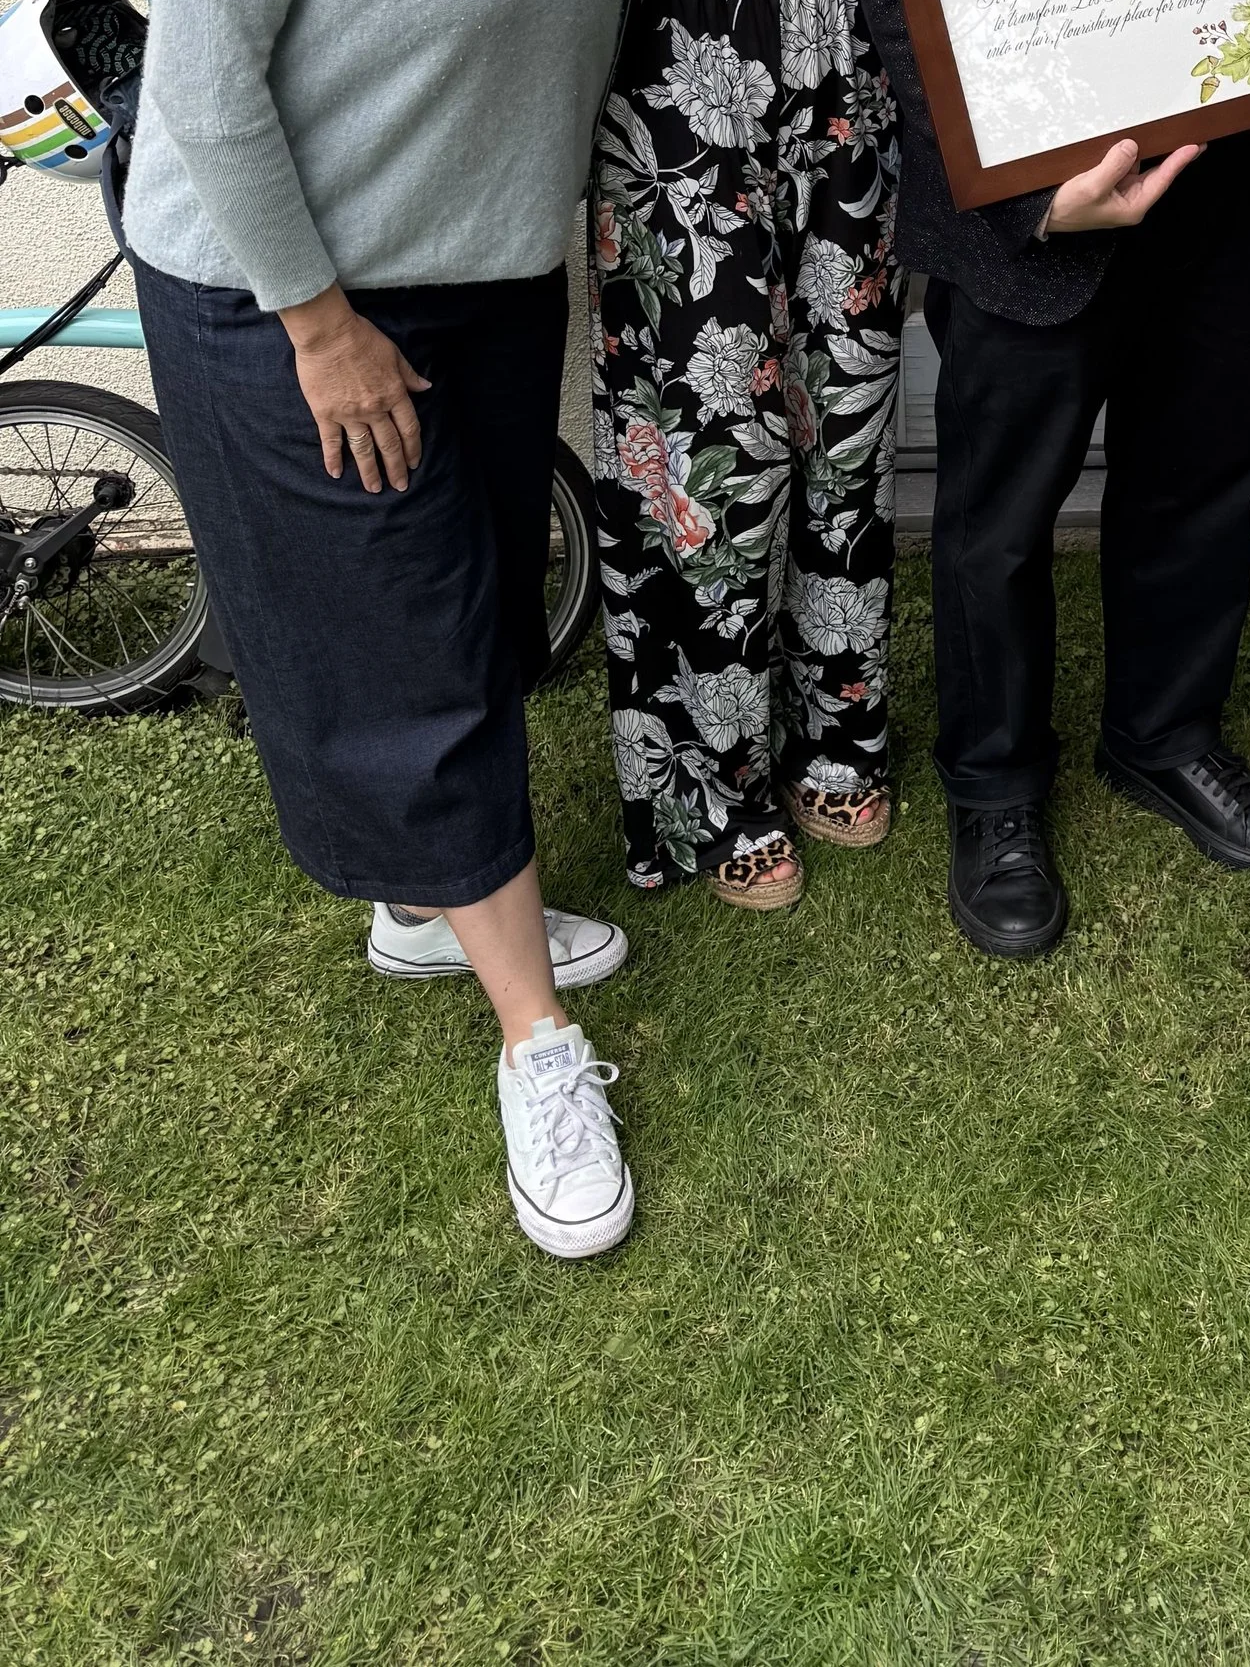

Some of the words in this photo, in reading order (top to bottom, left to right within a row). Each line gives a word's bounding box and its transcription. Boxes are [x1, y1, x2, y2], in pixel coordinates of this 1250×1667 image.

[986, 36, 1013, 60] into
[1024, 26, 1054, 55] fair,
[1053, 8, 1122, 49] flourishing
[1120, 1, 1154, 33] place
[993, 14, 1006, 32] to
[1007, 0, 1068, 27] transform
[554, 1052, 573, 1068] STAR
